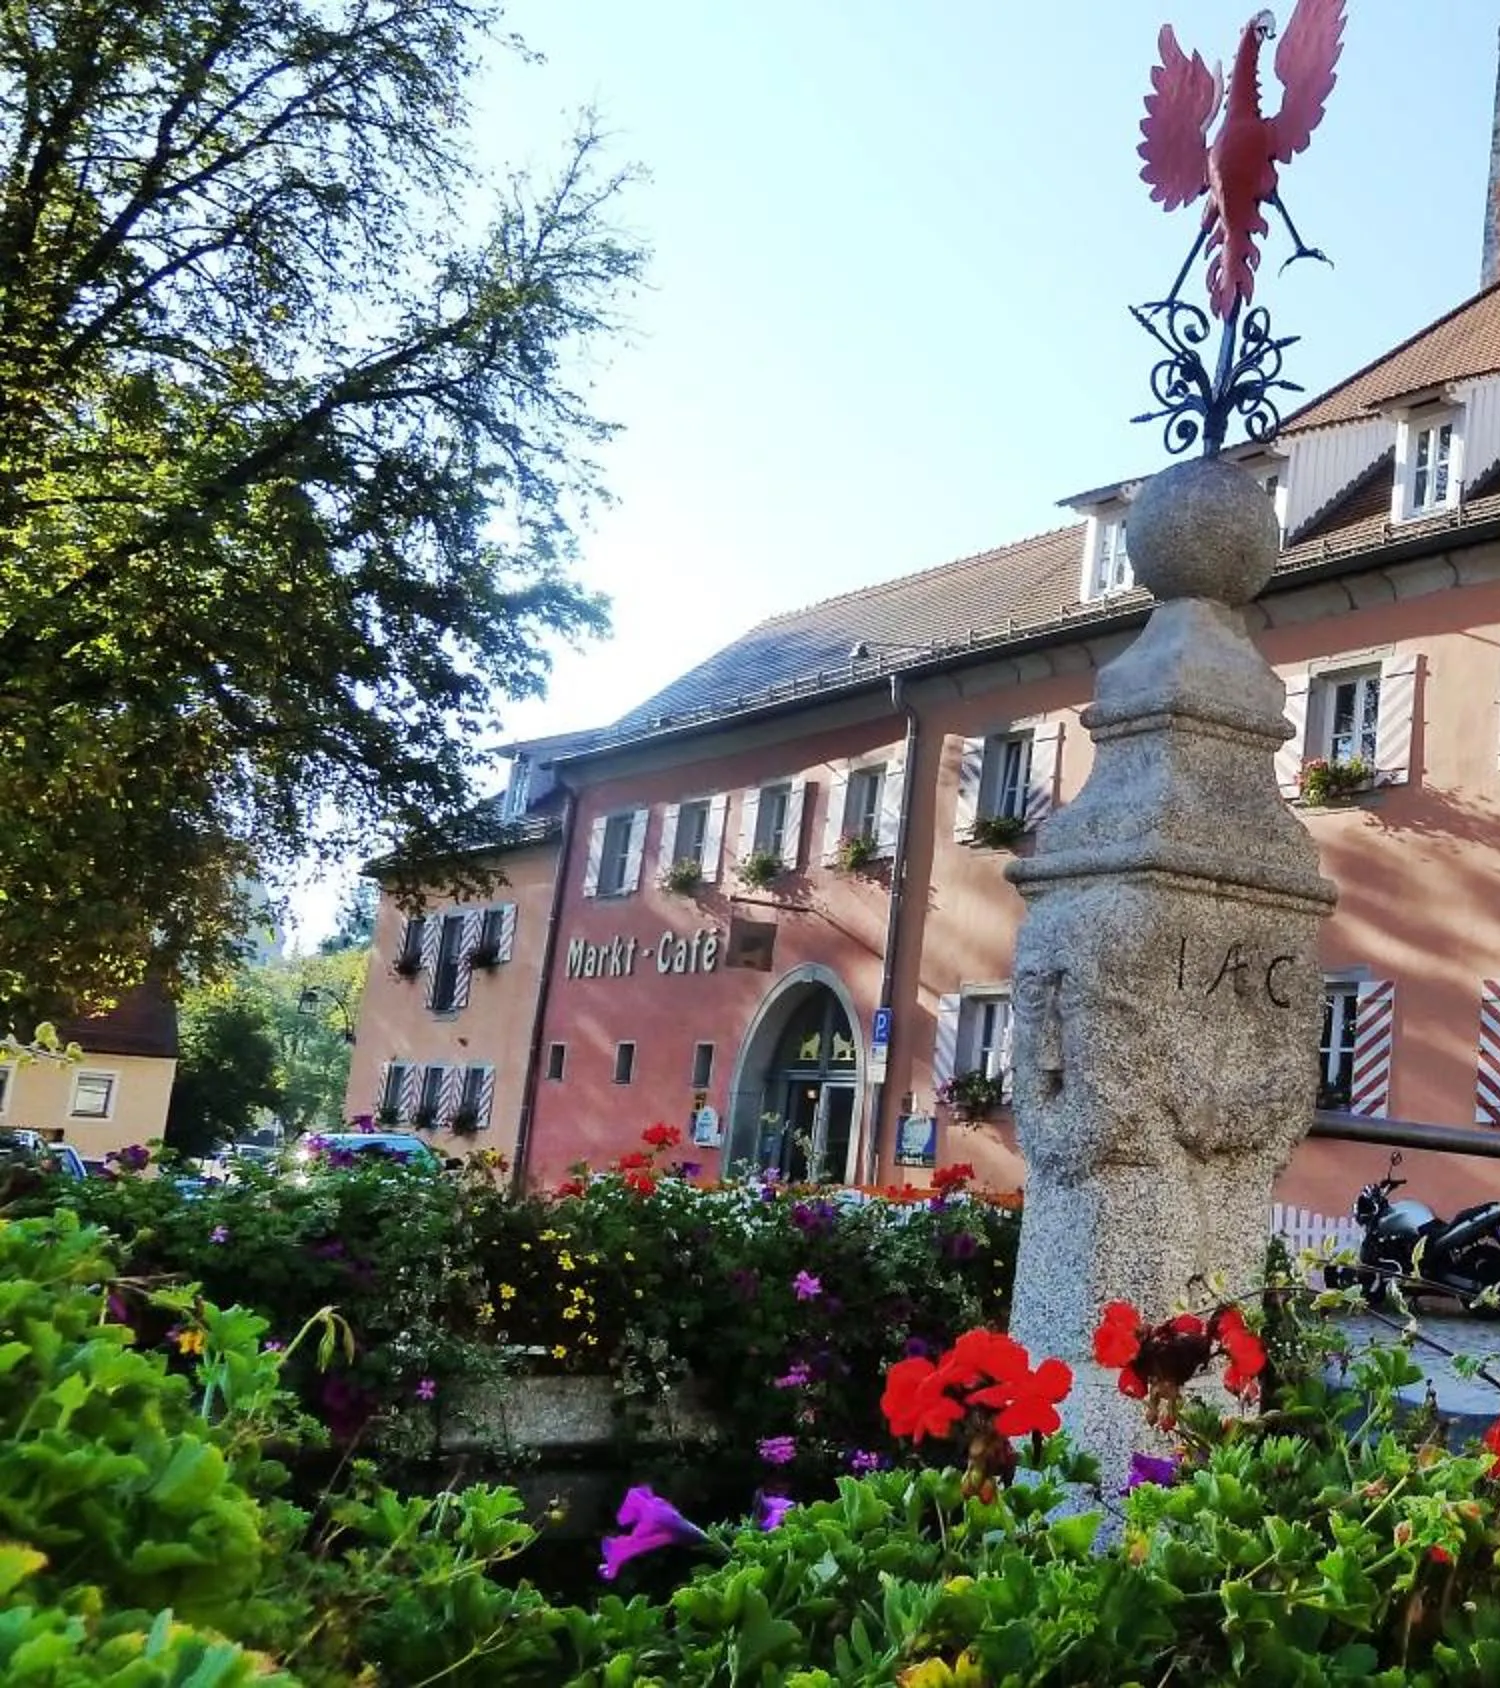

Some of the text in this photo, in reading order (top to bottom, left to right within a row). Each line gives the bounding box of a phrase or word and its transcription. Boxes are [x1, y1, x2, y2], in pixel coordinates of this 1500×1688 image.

[565, 935, 637, 979] Markt
[657, 926, 721, 974] Café
[875, 1013, 887, 1038] P
